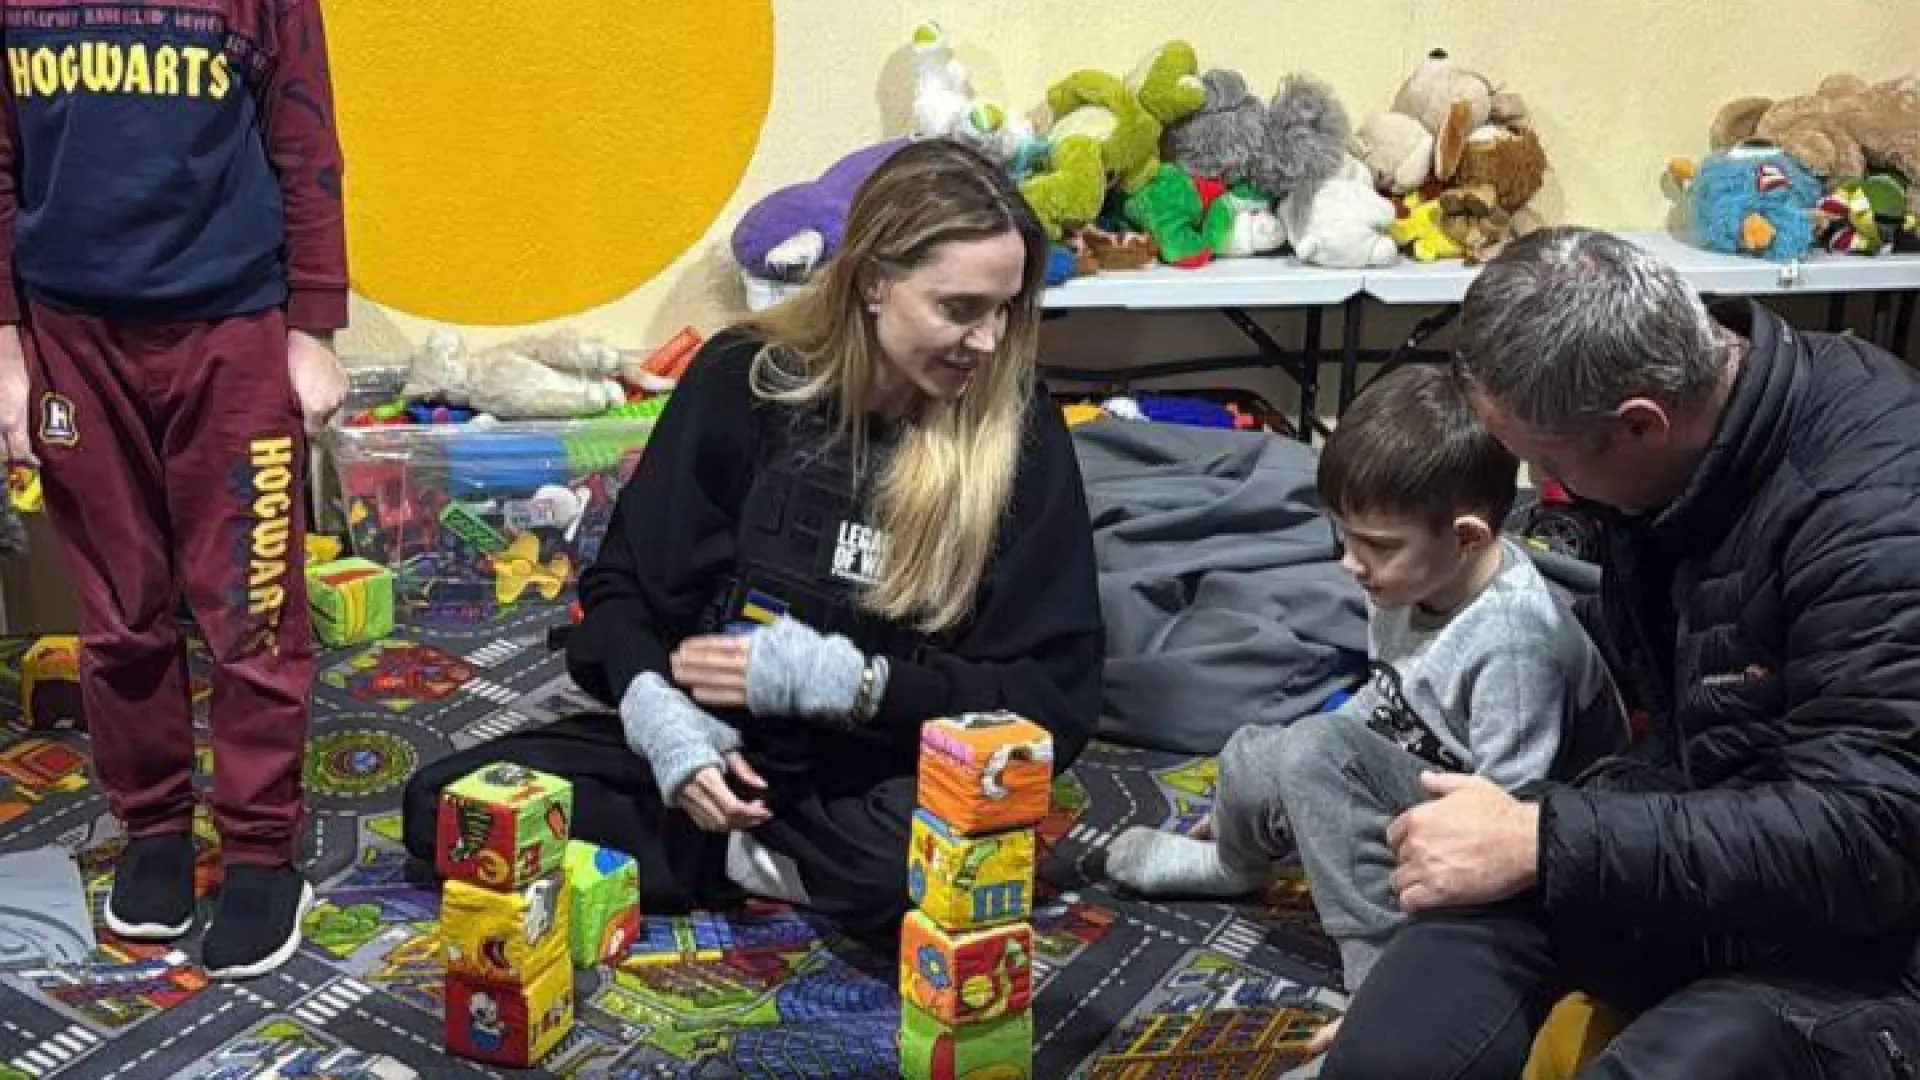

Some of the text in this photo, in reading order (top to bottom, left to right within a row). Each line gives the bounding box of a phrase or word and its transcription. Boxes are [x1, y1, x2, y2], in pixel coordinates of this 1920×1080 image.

[7, 42, 230, 99] HOGWARTS
[248, 436, 293, 657] HOGWAR
[837, 519, 889, 553] LEGA
